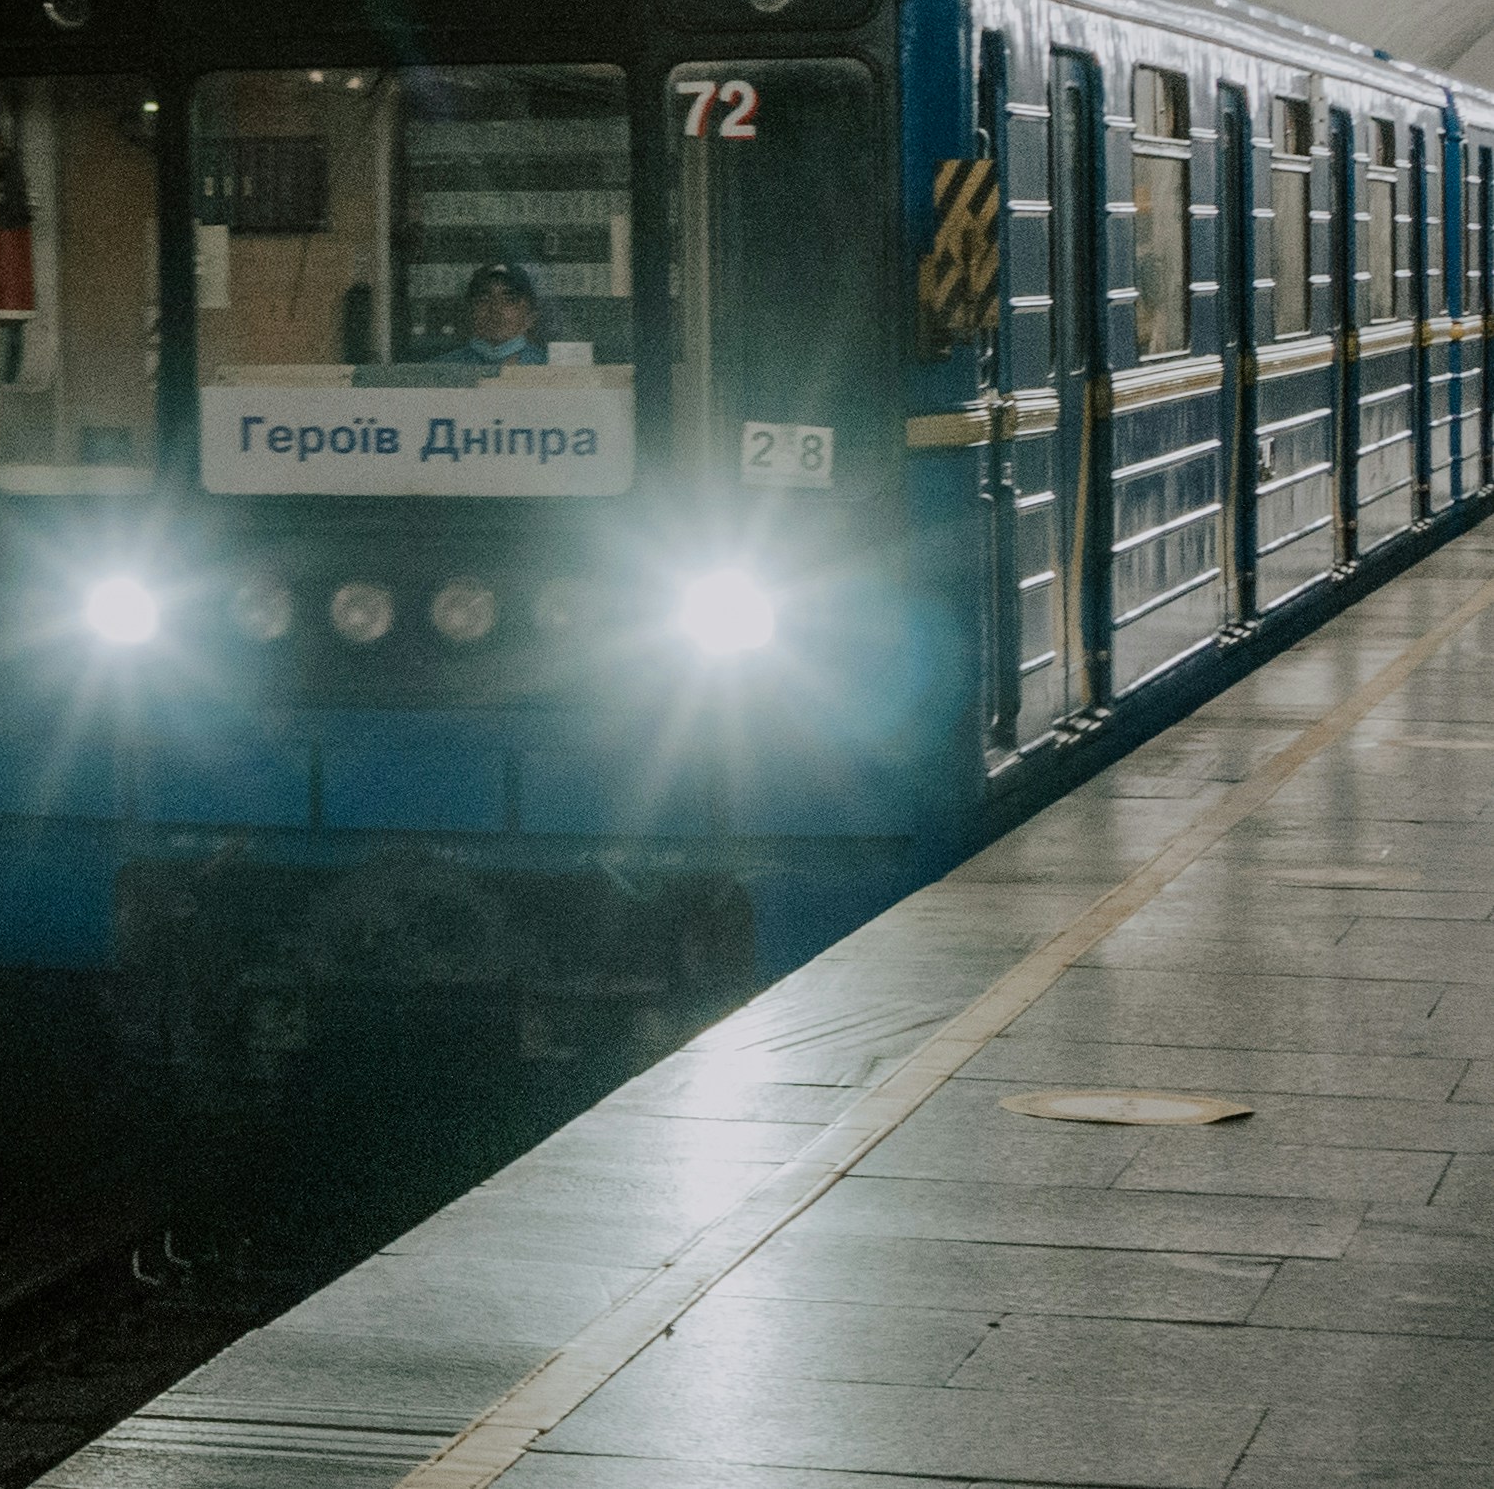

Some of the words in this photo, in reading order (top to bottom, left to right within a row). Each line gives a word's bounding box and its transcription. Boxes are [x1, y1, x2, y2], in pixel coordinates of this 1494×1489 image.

[675, 80, 759, 140] 72
[239, 416, 400, 462] Героїв
[420, 417, 598, 465] Дніпра
